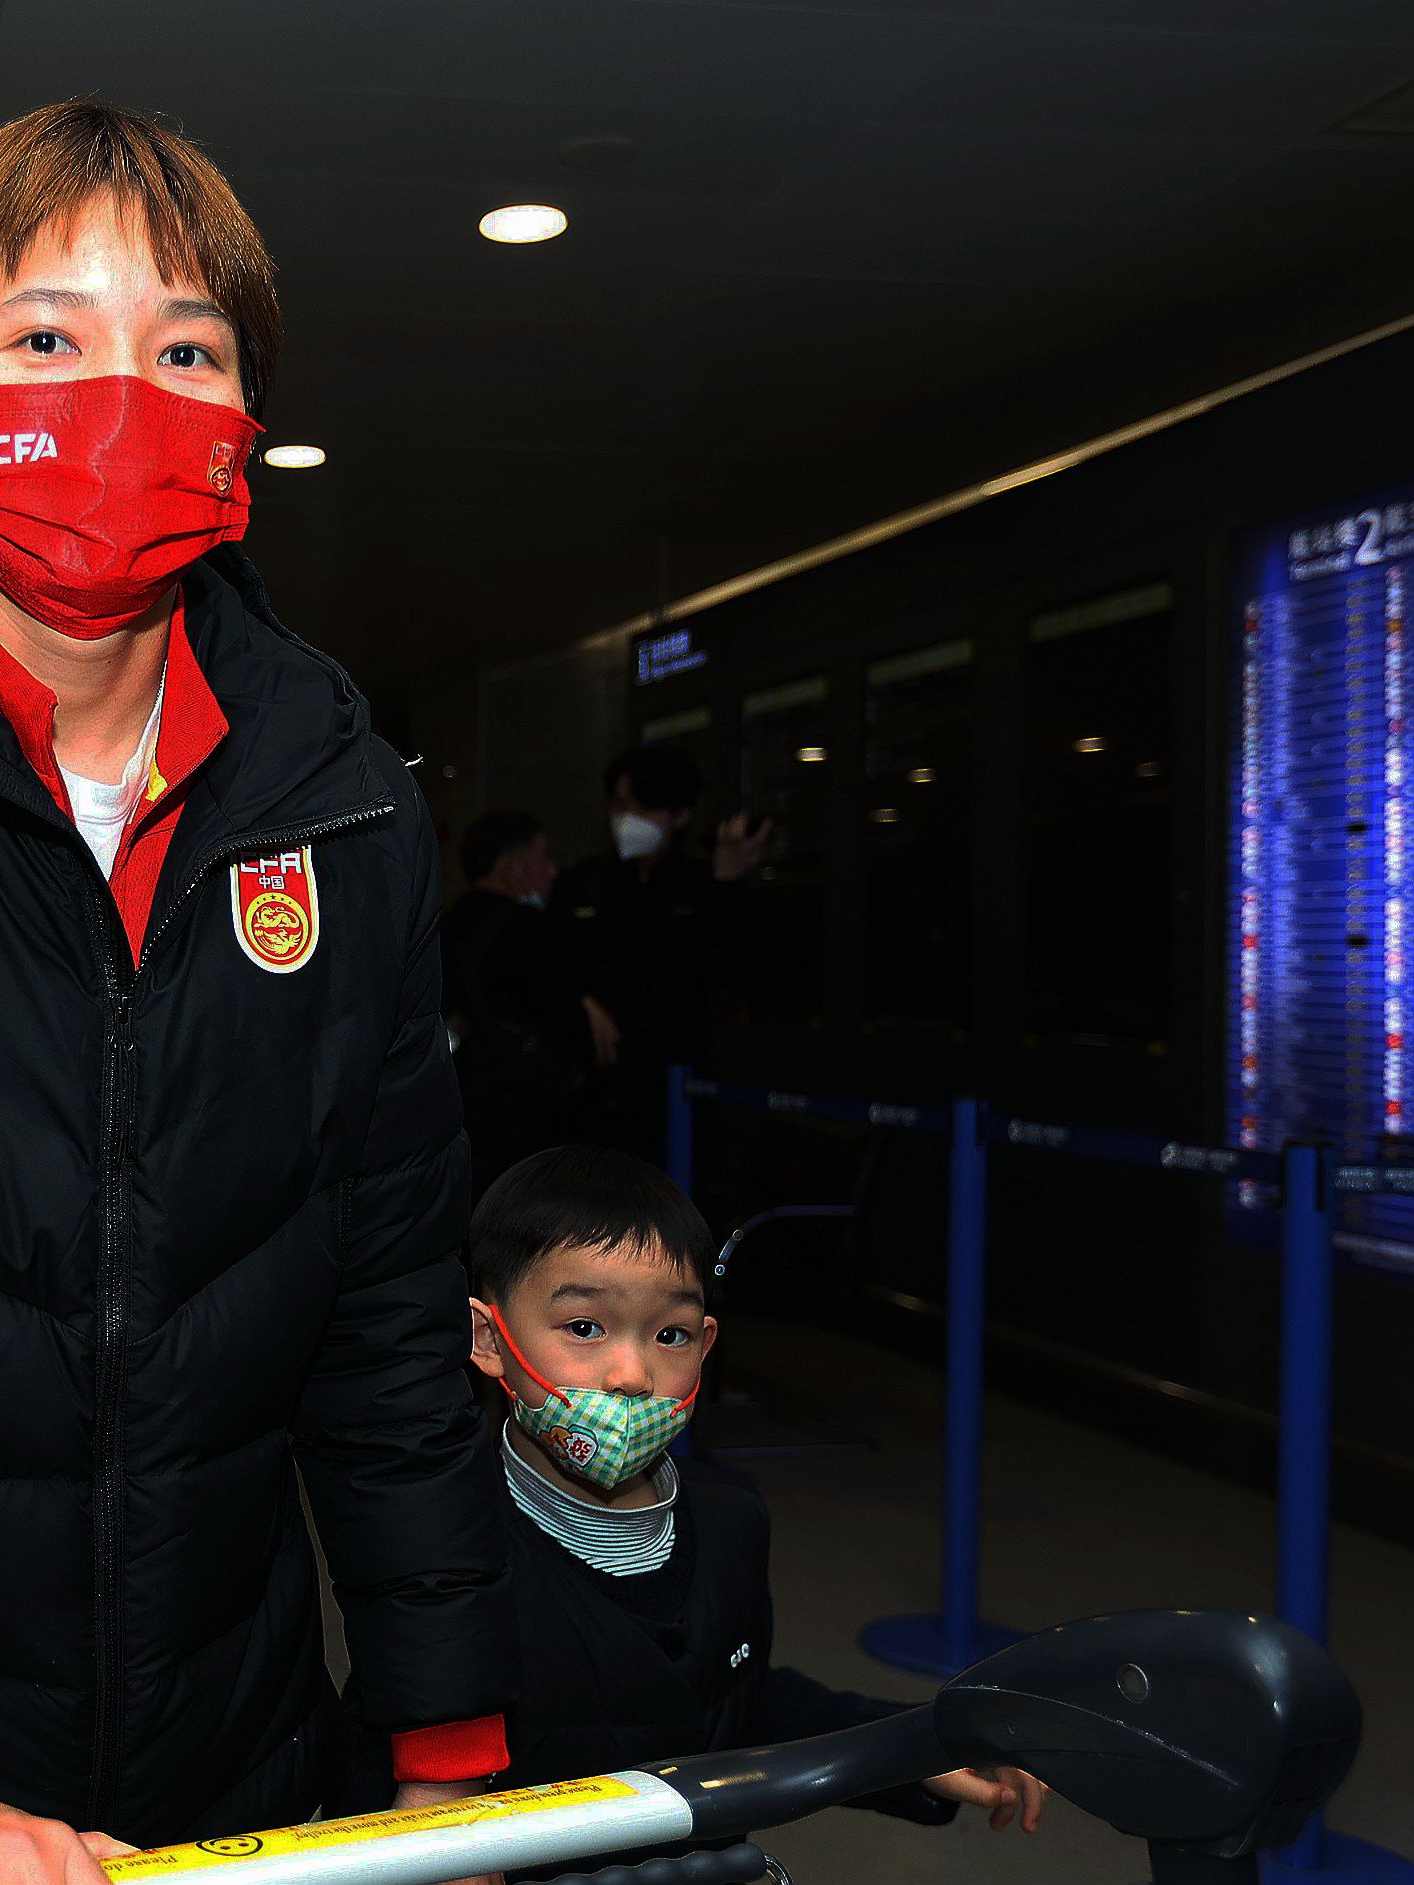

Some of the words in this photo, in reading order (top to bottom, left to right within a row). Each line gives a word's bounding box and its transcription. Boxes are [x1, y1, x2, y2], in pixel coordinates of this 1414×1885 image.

[258, 875, 285, 890] 中国
[104, 1862, 123, 1872] do
[126, 1855, 177, 1867] Please
